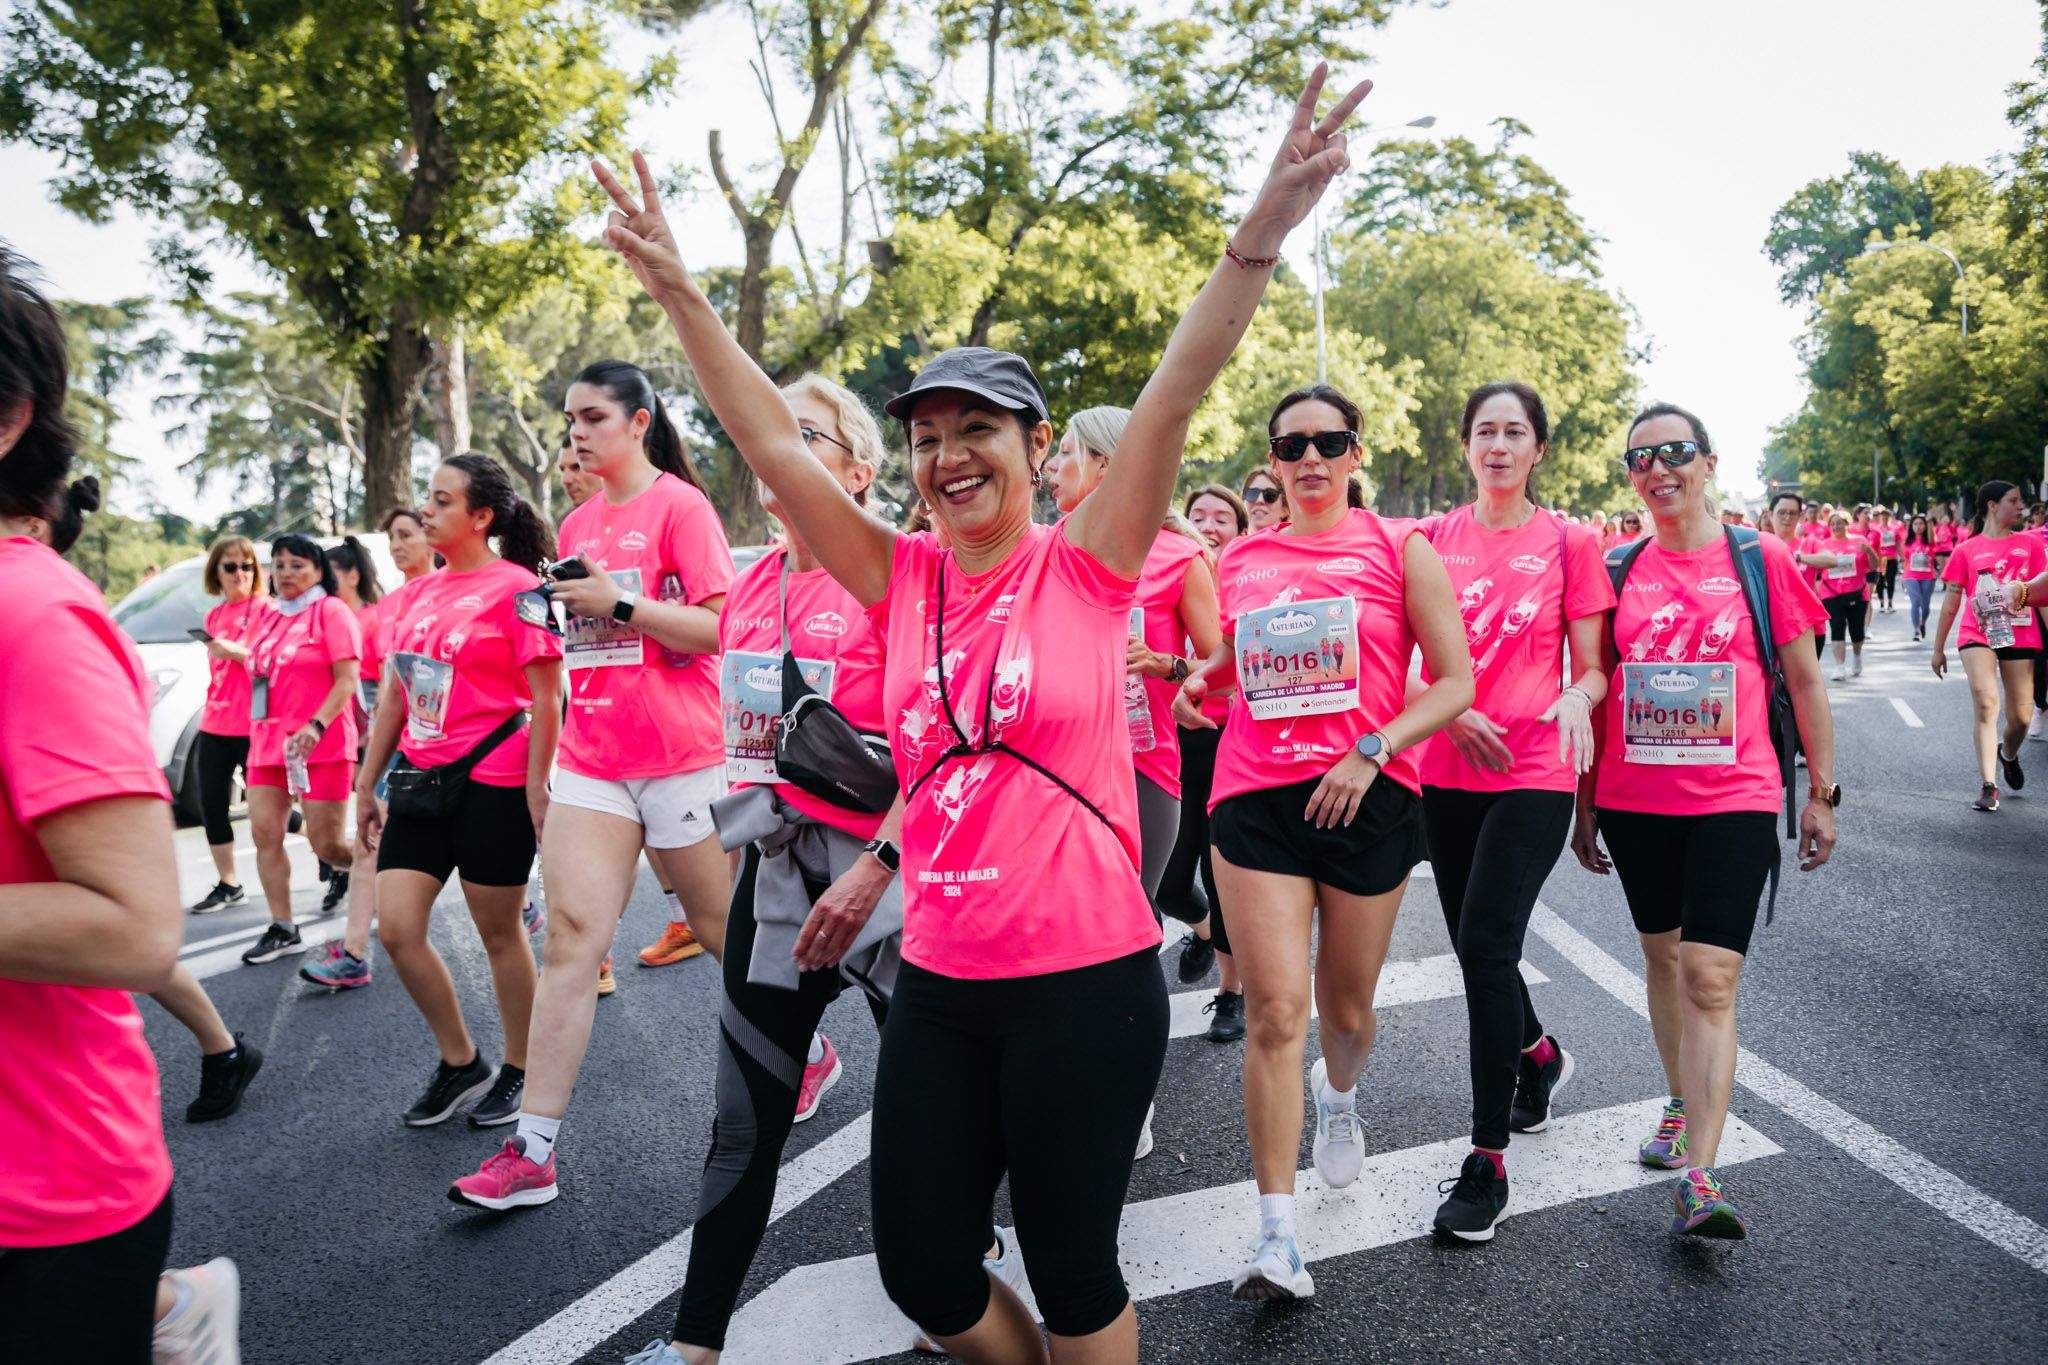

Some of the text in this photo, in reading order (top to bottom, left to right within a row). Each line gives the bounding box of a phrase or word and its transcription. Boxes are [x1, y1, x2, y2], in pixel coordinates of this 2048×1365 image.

[1236, 568, 1278, 587] OYSHO
[1624, 583, 1663, 593] OSHO
[1269, 621, 1314, 633] ASTURIANA
[1273, 651, 1319, 673] 016
[749, 671, 782, 686] ASTURIA
[1287, 676, 1304, 686] 127
[1653, 677, 1696, 687] ASTURIANA
[1252, 691, 1278, 699] CARRERA
[1295, 684, 1317, 694] MUJER
[1320, 682, 1346, 691] MADRID
[1254, 697, 1348, 713] OYSHO Santander
[1653, 708, 1697, 725] 016
[1661, 729, 1687, 737] 12516
[744, 737, 774, 749] 12519
[1633, 737, 1655, 745] CARRERA
[1632, 749, 1664, 758] OYSHO
[943, 871, 955, 882] DE
[956, 871, 966, 882] LA
[967, 868, 998, 882] MUJER
[943, 885, 961, 896] 2024
